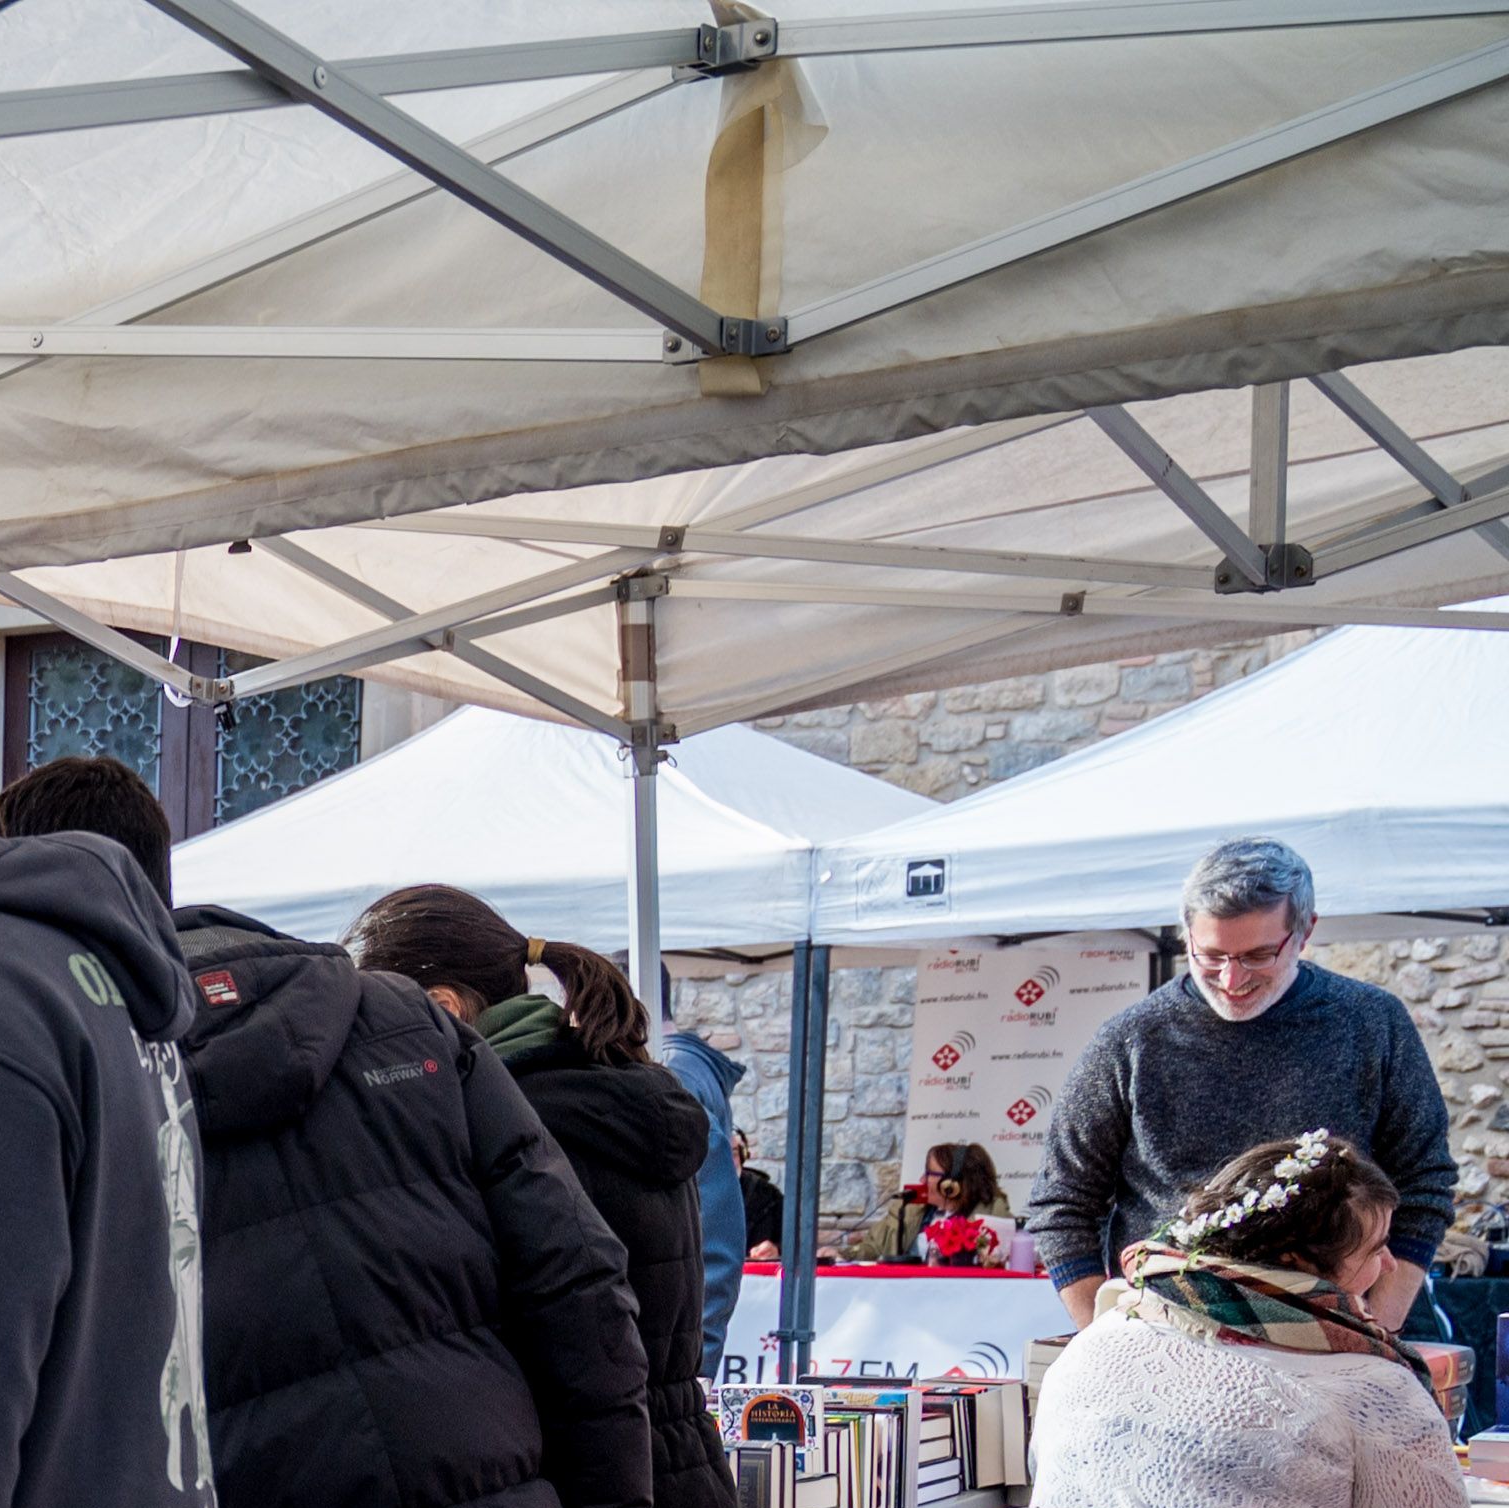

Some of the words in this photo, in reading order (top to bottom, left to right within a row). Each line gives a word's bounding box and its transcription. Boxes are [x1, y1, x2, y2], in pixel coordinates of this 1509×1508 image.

[1069, 982, 1140, 995] www.radiorubi.fm
[920, 992, 988, 1004] www.radiorubi.fm
[991, 1050, 1063, 1061] www.radiorubi.fm
[363, 1066, 425, 1088] NORWAY
[911, 1111, 980, 1121] www.radiorubi.fm
[767, 1403, 779, 1411] LA
[751, 1409, 796, 1418] HISTORIA
